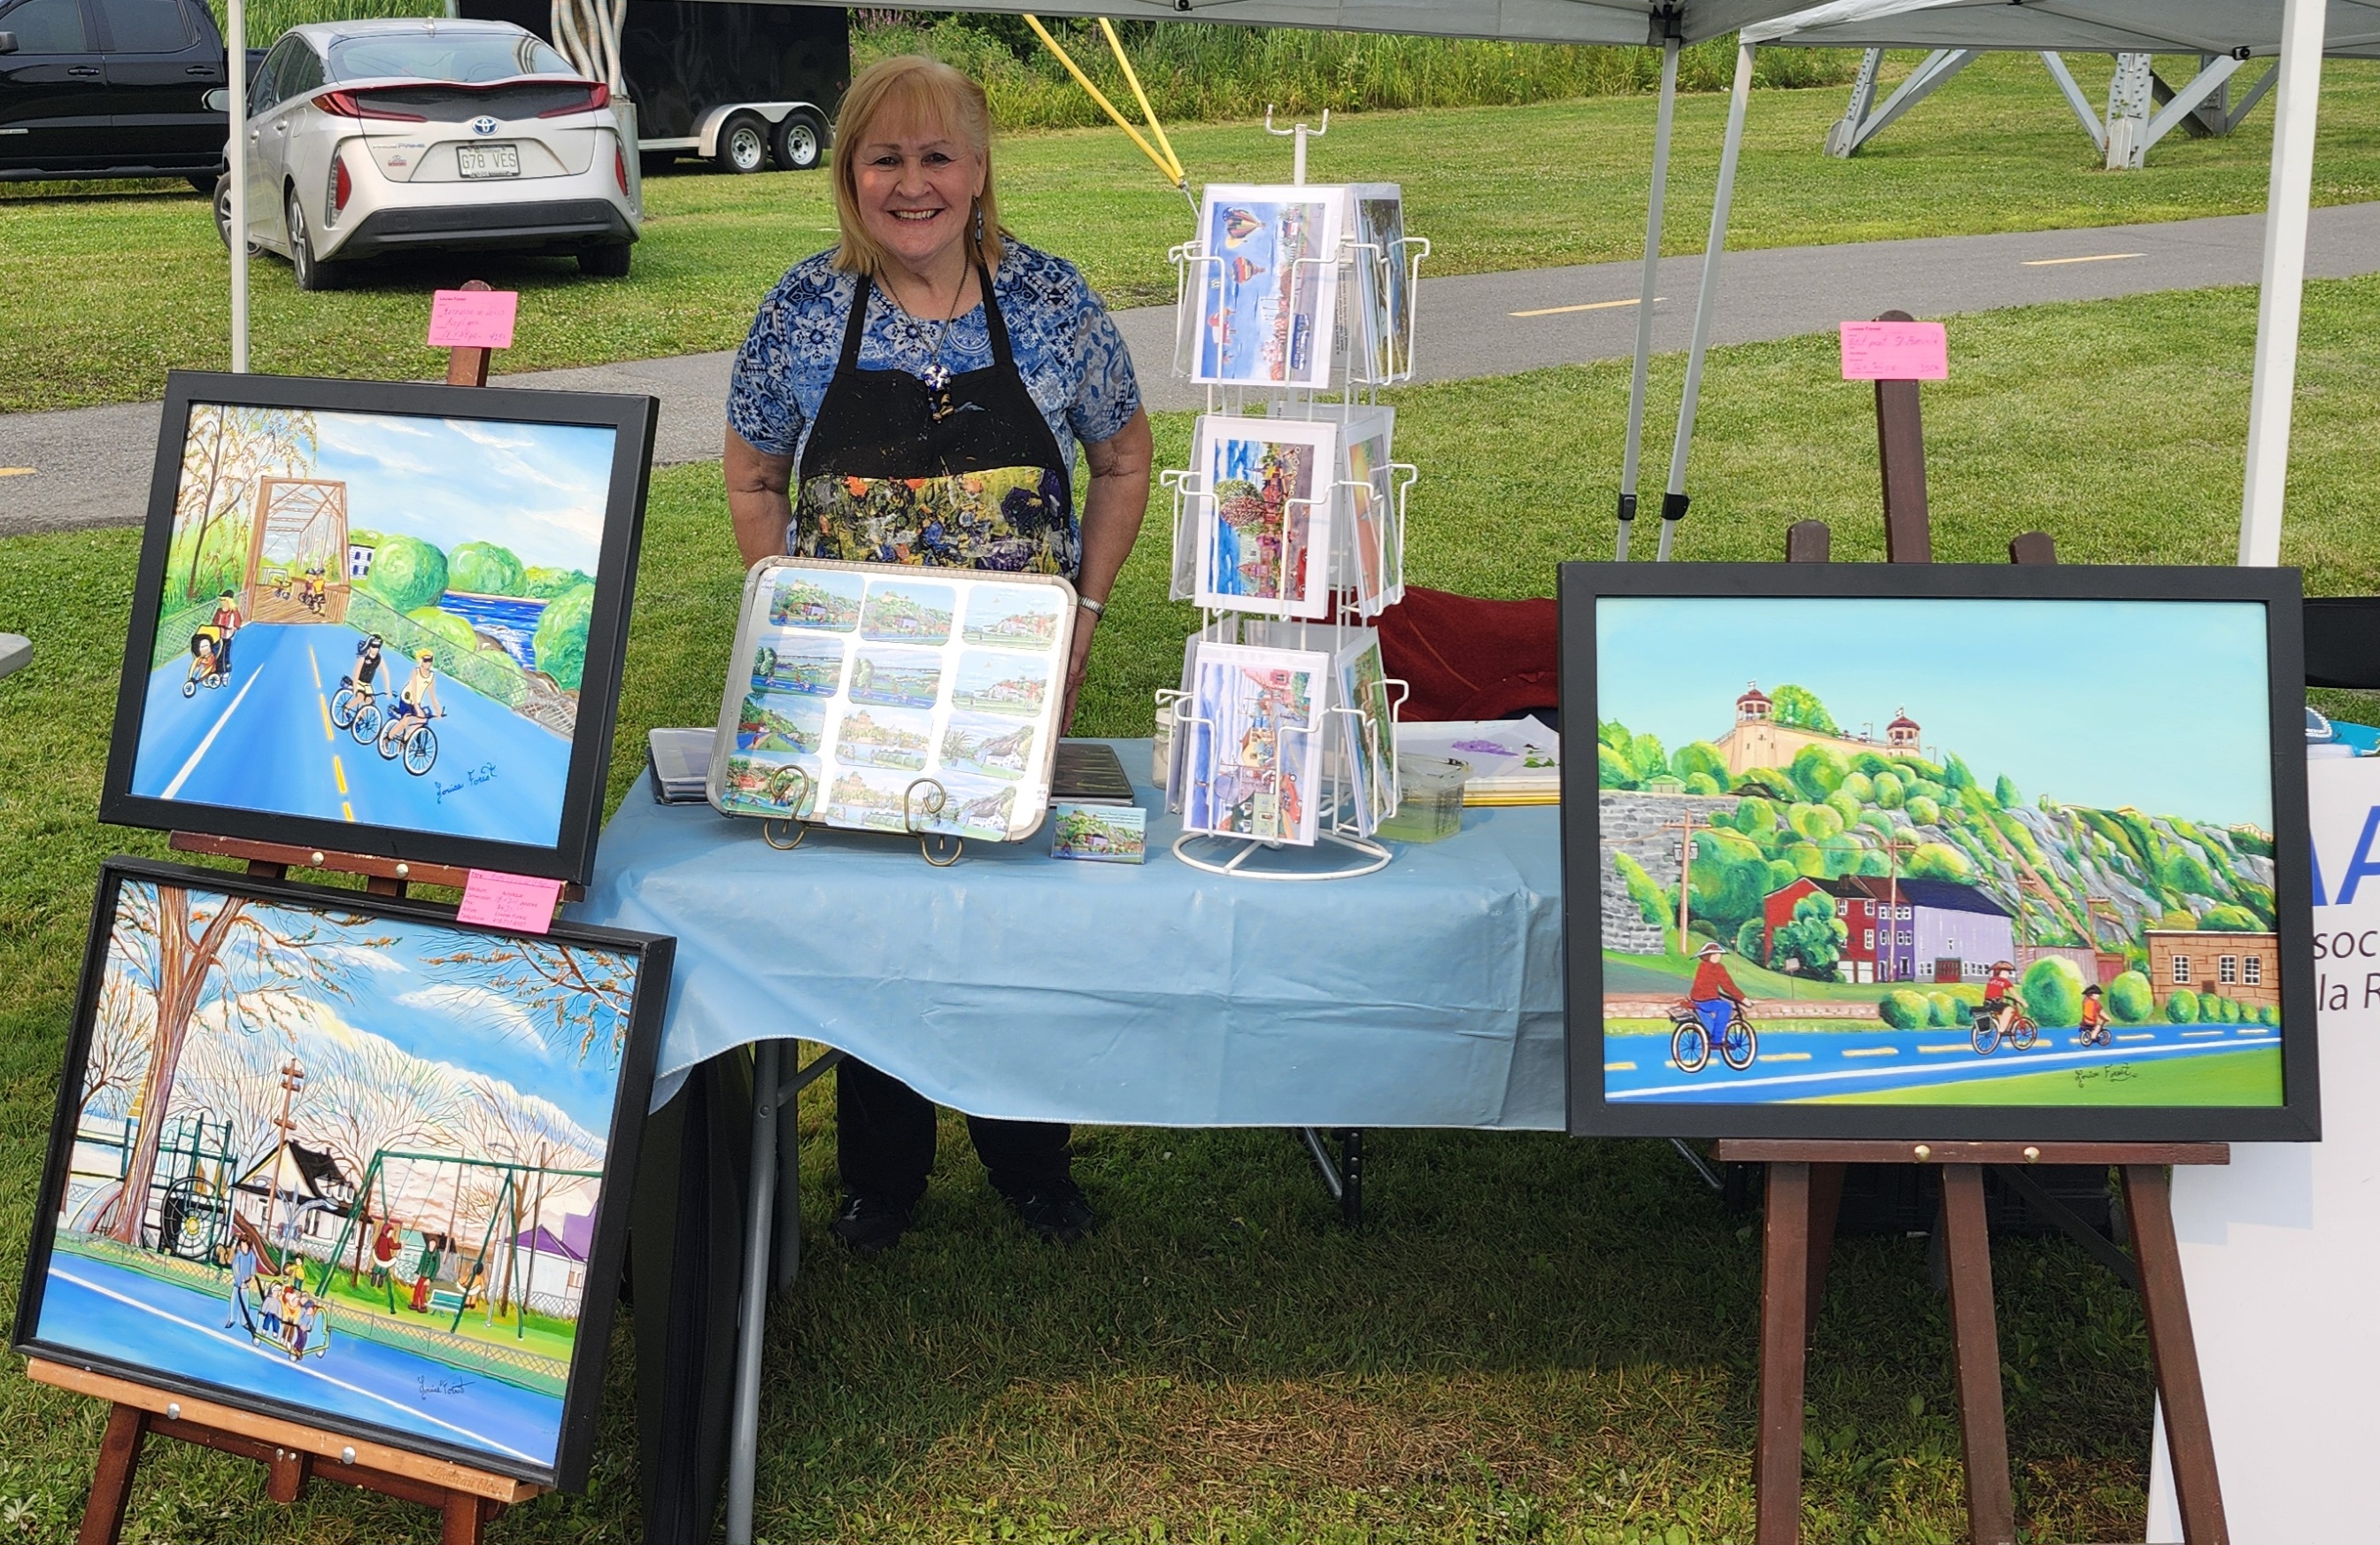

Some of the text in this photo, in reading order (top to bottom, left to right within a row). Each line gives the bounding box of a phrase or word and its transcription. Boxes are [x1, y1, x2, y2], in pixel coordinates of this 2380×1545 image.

[461, 152, 517, 169] G78 VES
[2310, 805, 2380, 906] A
[2319, 974, 2347, 1011] la
